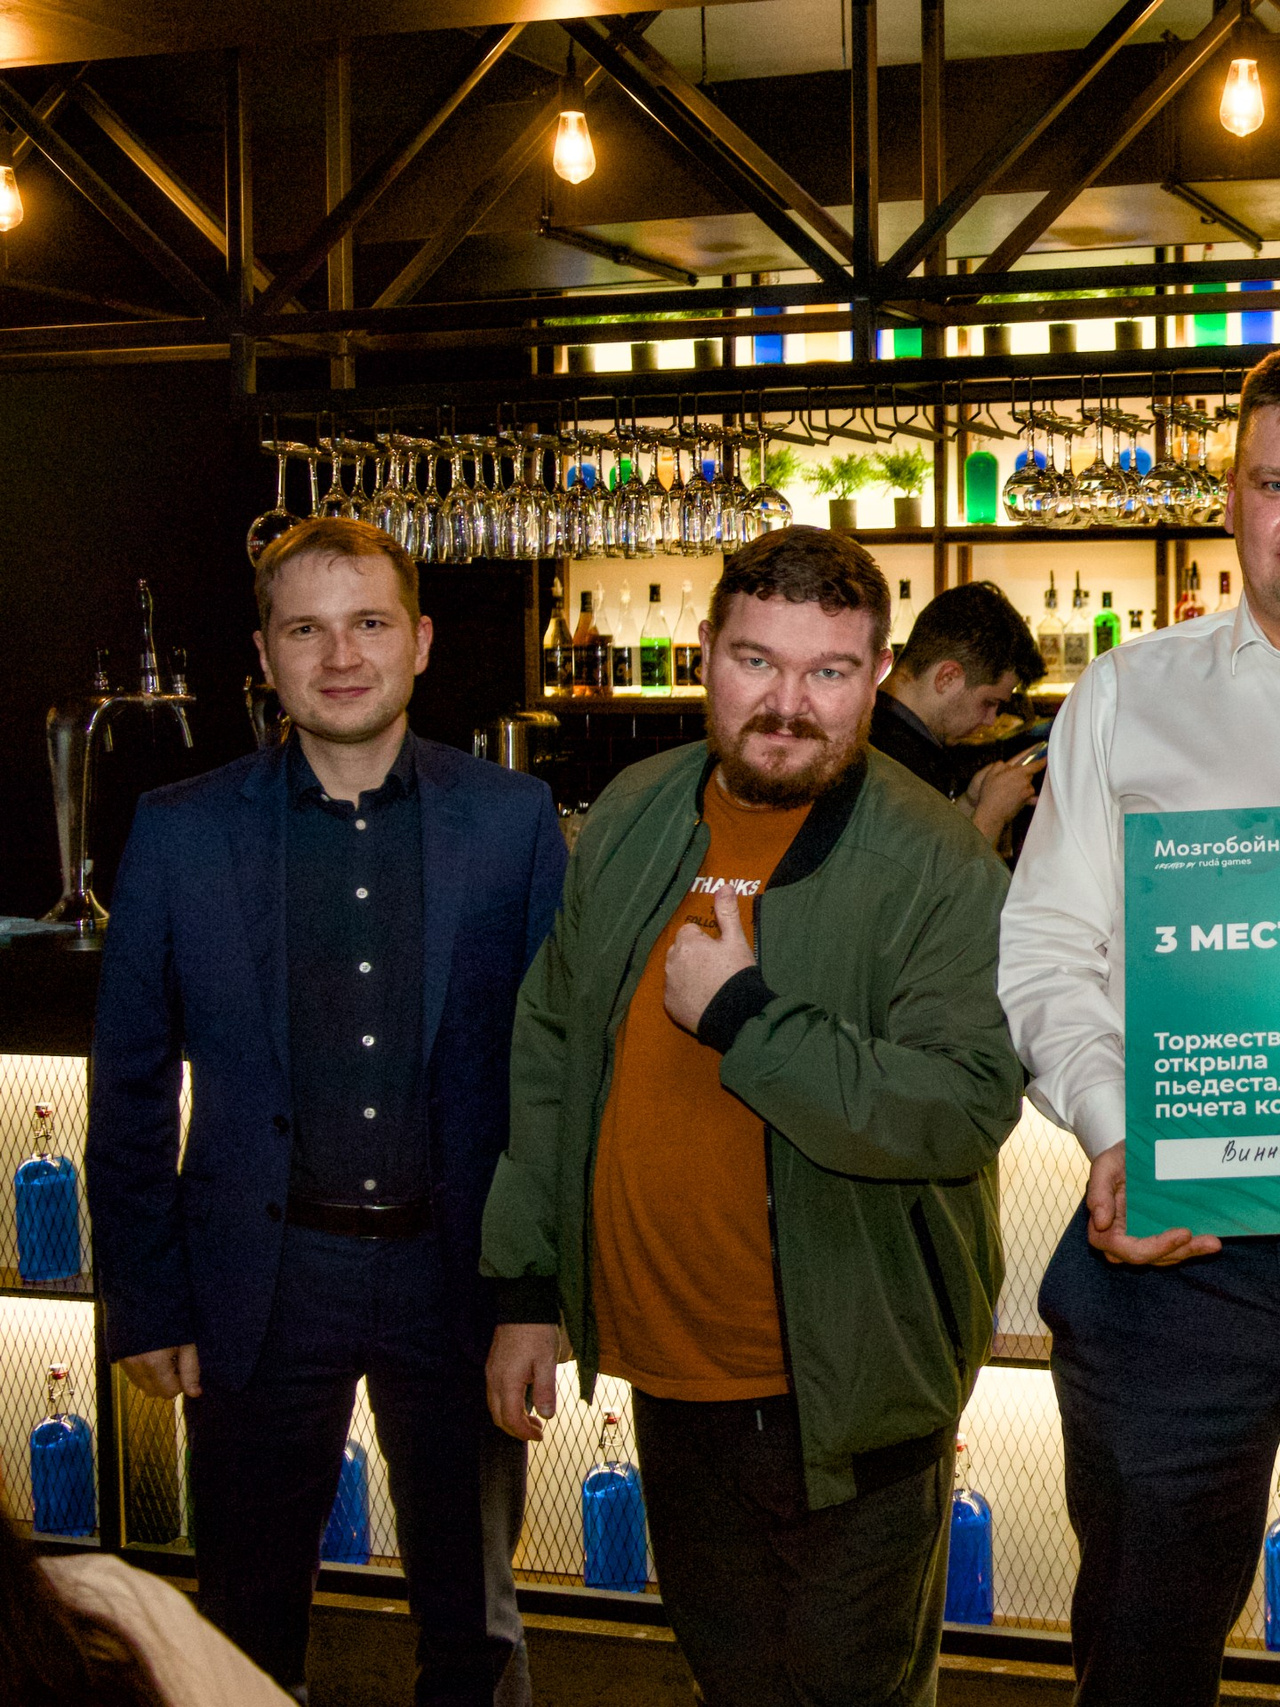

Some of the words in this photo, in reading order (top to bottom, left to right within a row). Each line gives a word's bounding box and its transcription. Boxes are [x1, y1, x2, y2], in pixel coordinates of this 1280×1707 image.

[1221, 858, 1252, 868] games
[690, 876, 761, 896] THANKS
[1154, 925, 1178, 953] 3
[1154, 1054, 1268, 1075] открыла
[1155, 1100, 1247, 1119] почета
